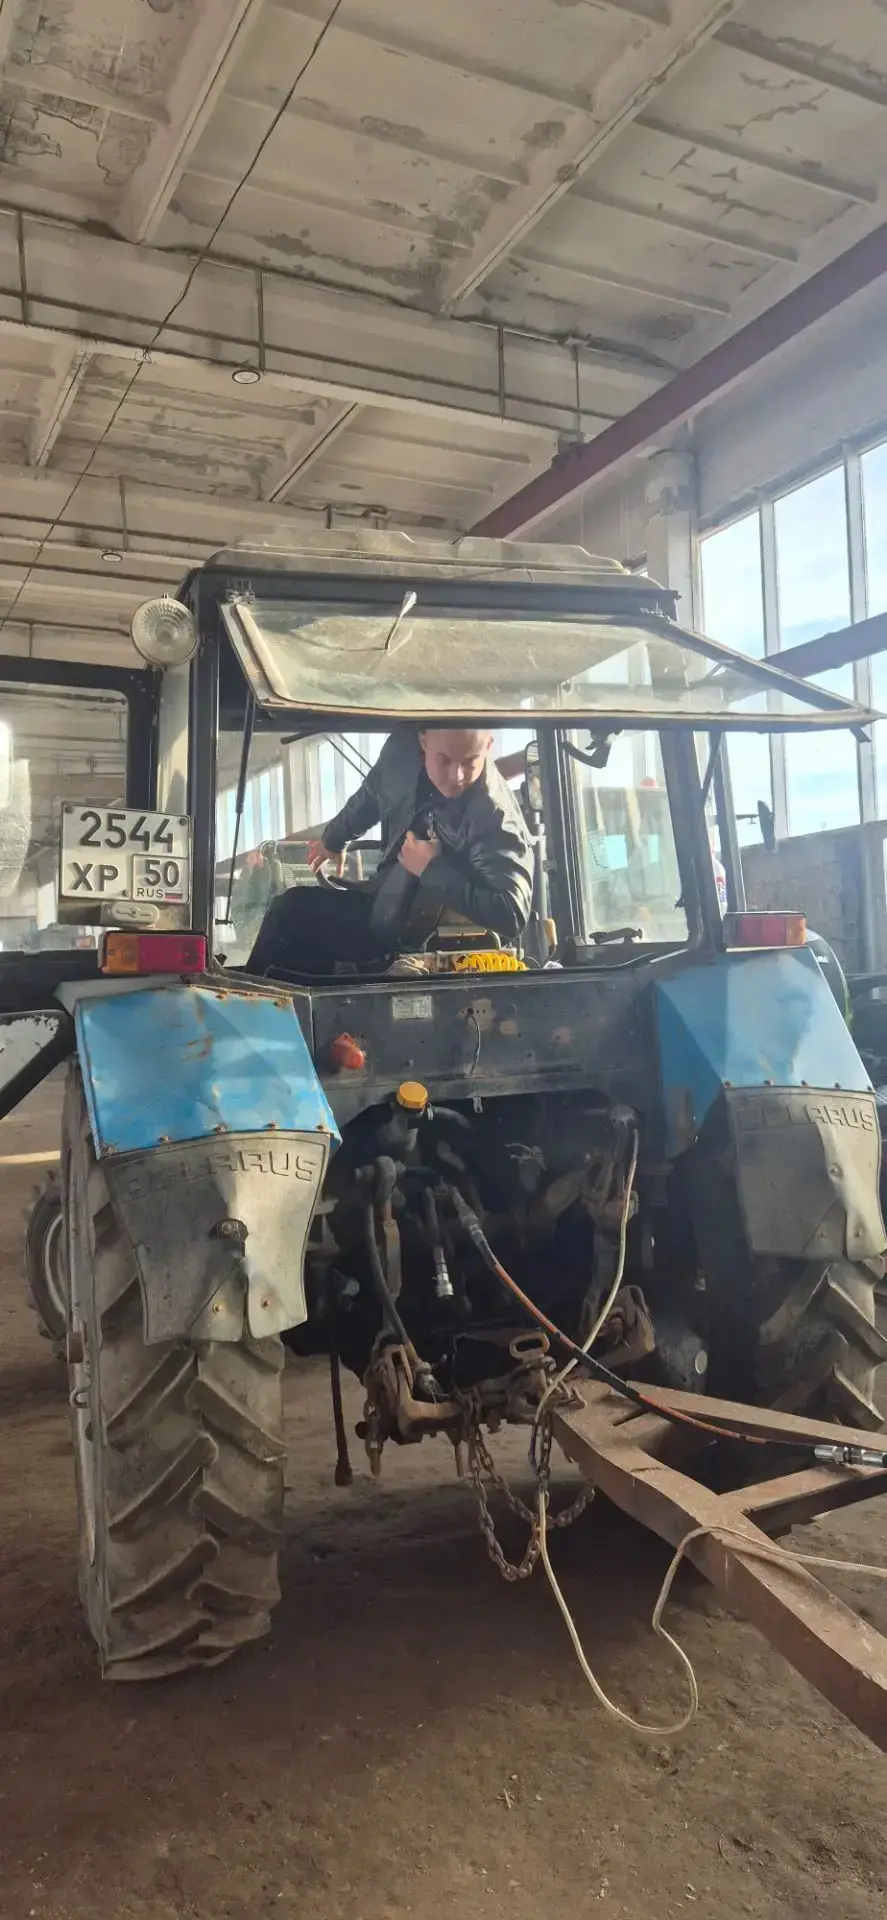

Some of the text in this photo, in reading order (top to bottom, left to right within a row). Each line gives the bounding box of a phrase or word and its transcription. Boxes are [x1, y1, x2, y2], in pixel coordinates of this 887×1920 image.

[79, 810, 174, 853] 2544
[144, 859, 180, 888] 50
[136, 887, 164, 899] RUS
